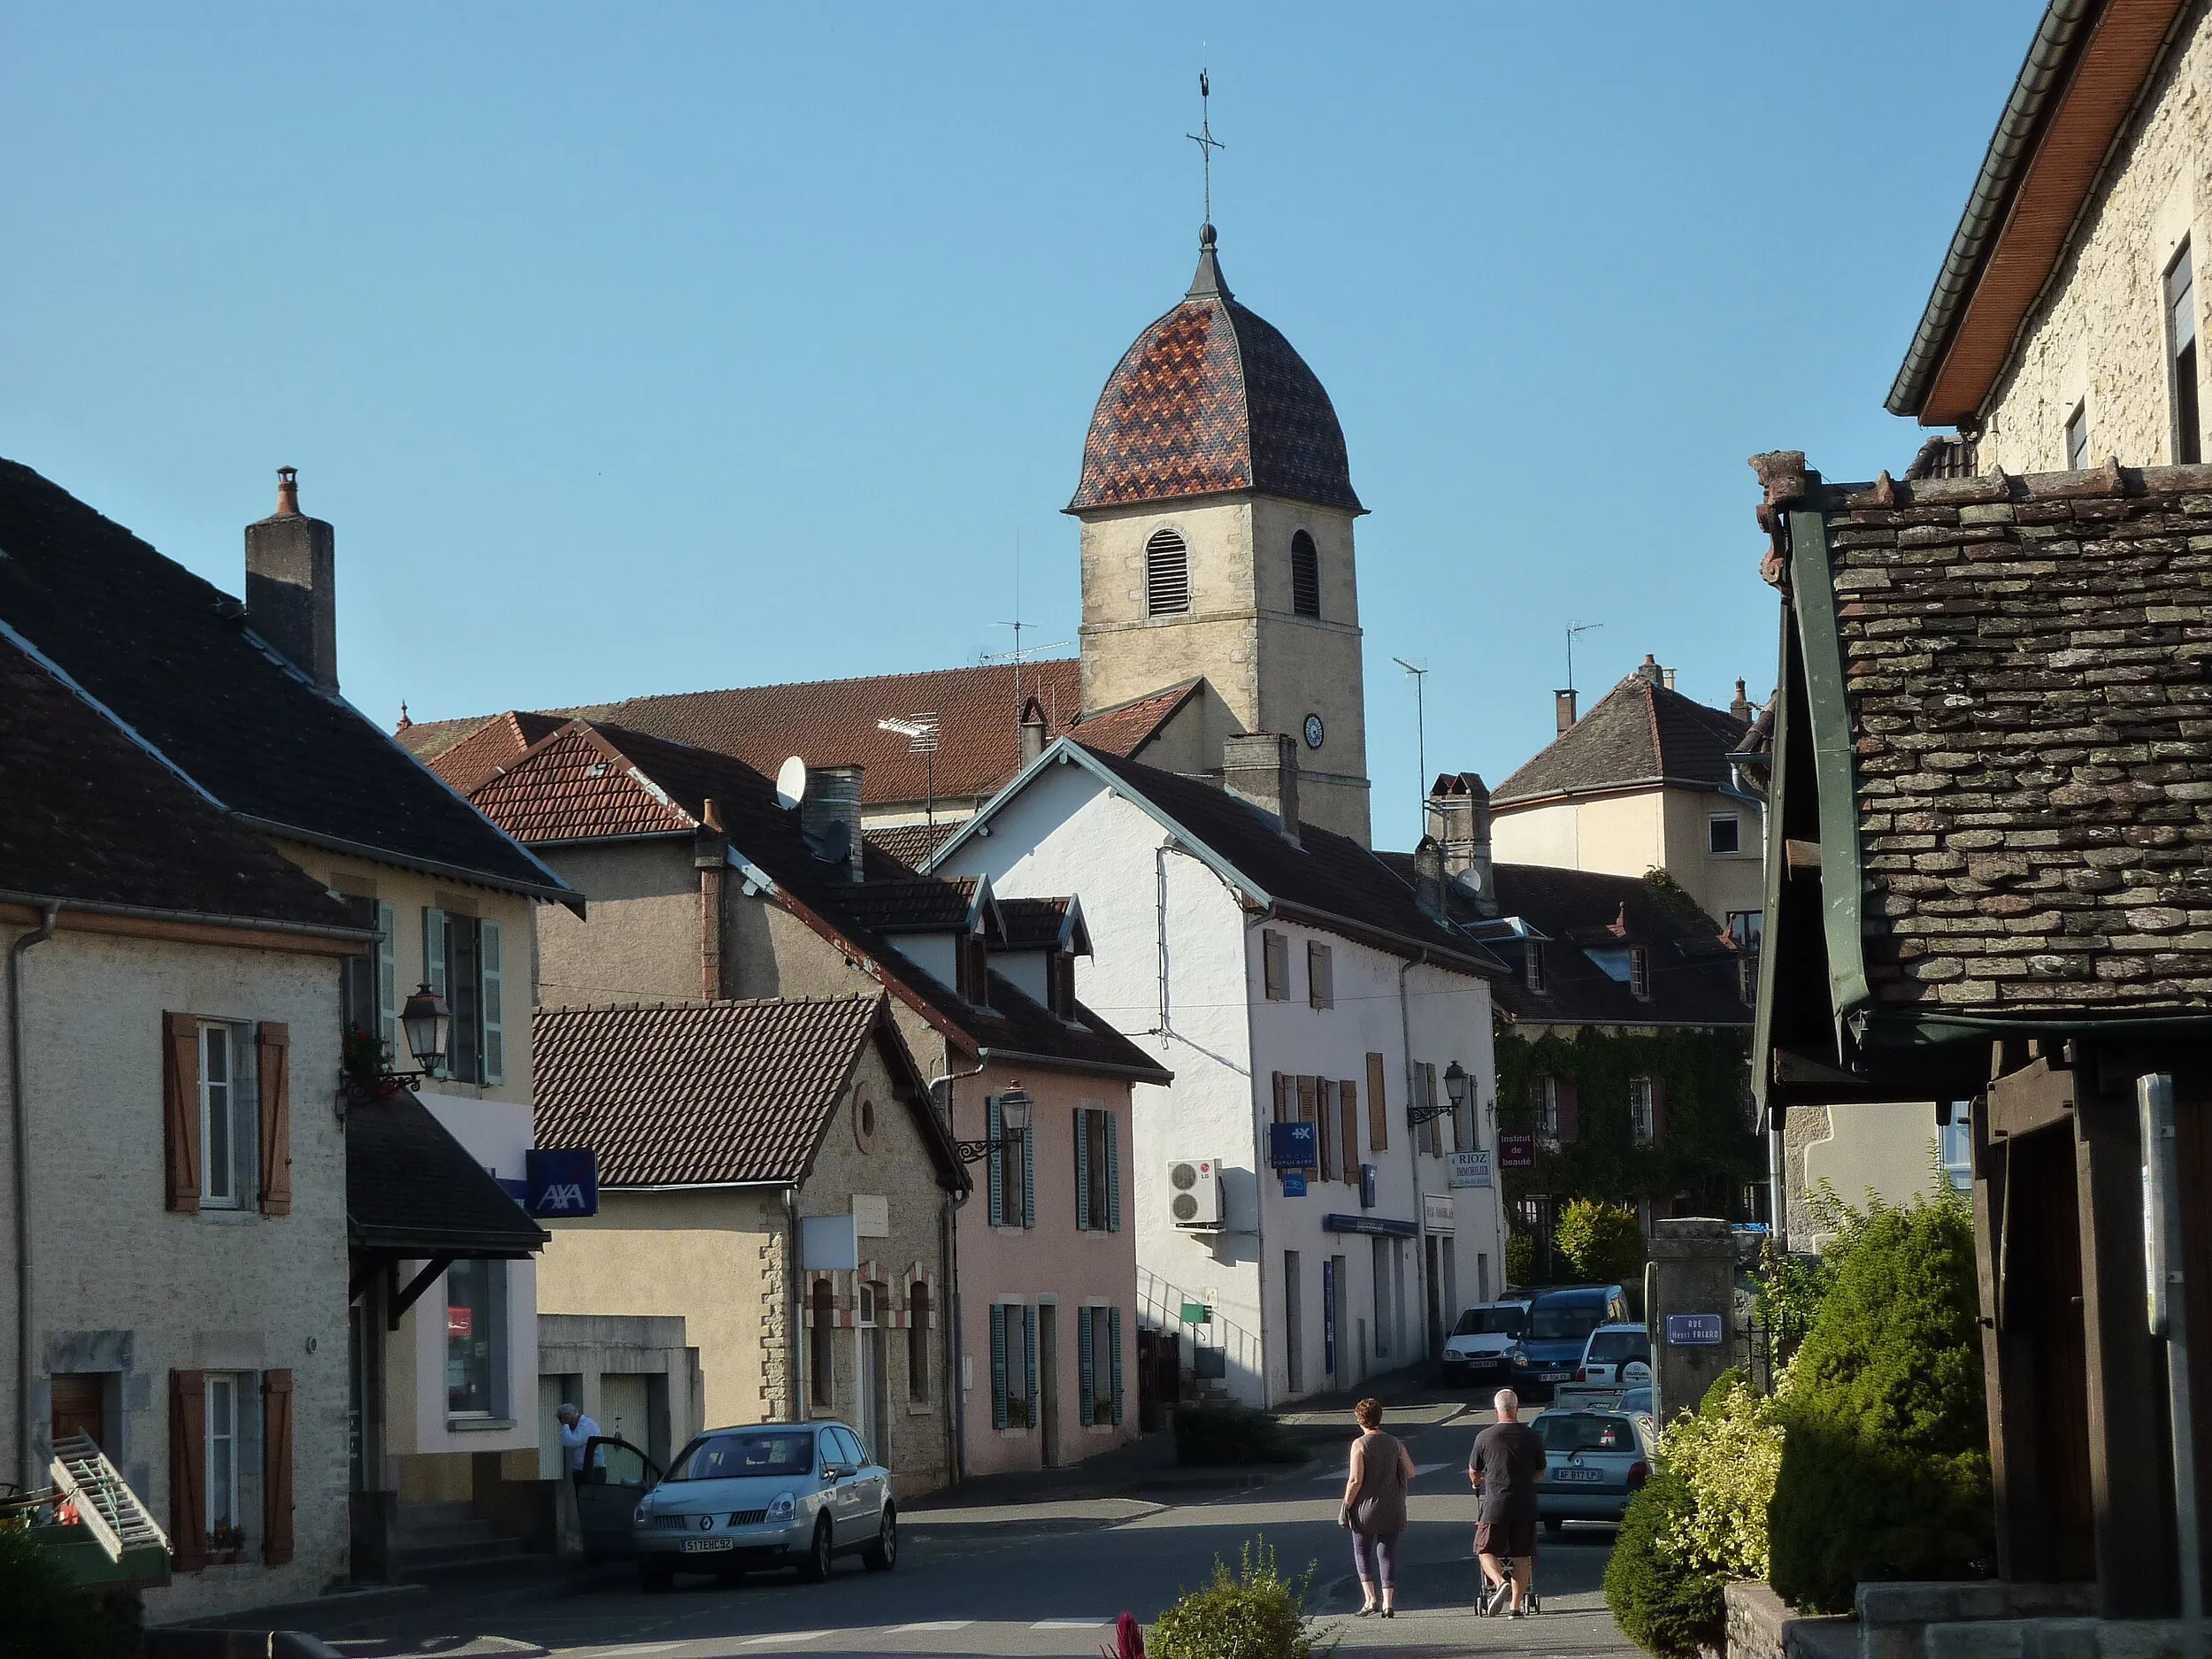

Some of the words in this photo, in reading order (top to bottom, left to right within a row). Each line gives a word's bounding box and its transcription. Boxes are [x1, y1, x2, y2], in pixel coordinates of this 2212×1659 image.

[1501, 1134, 1531, 1143] Institut
[1459, 1153, 1487, 1164] RIOZ
[1502, 1156, 1532, 1166] beauté
[535, 1183, 587, 1211] AXA
[1687, 1319, 1702, 1328] RUE
[1693, 1330, 1719, 1339] FRIARD
